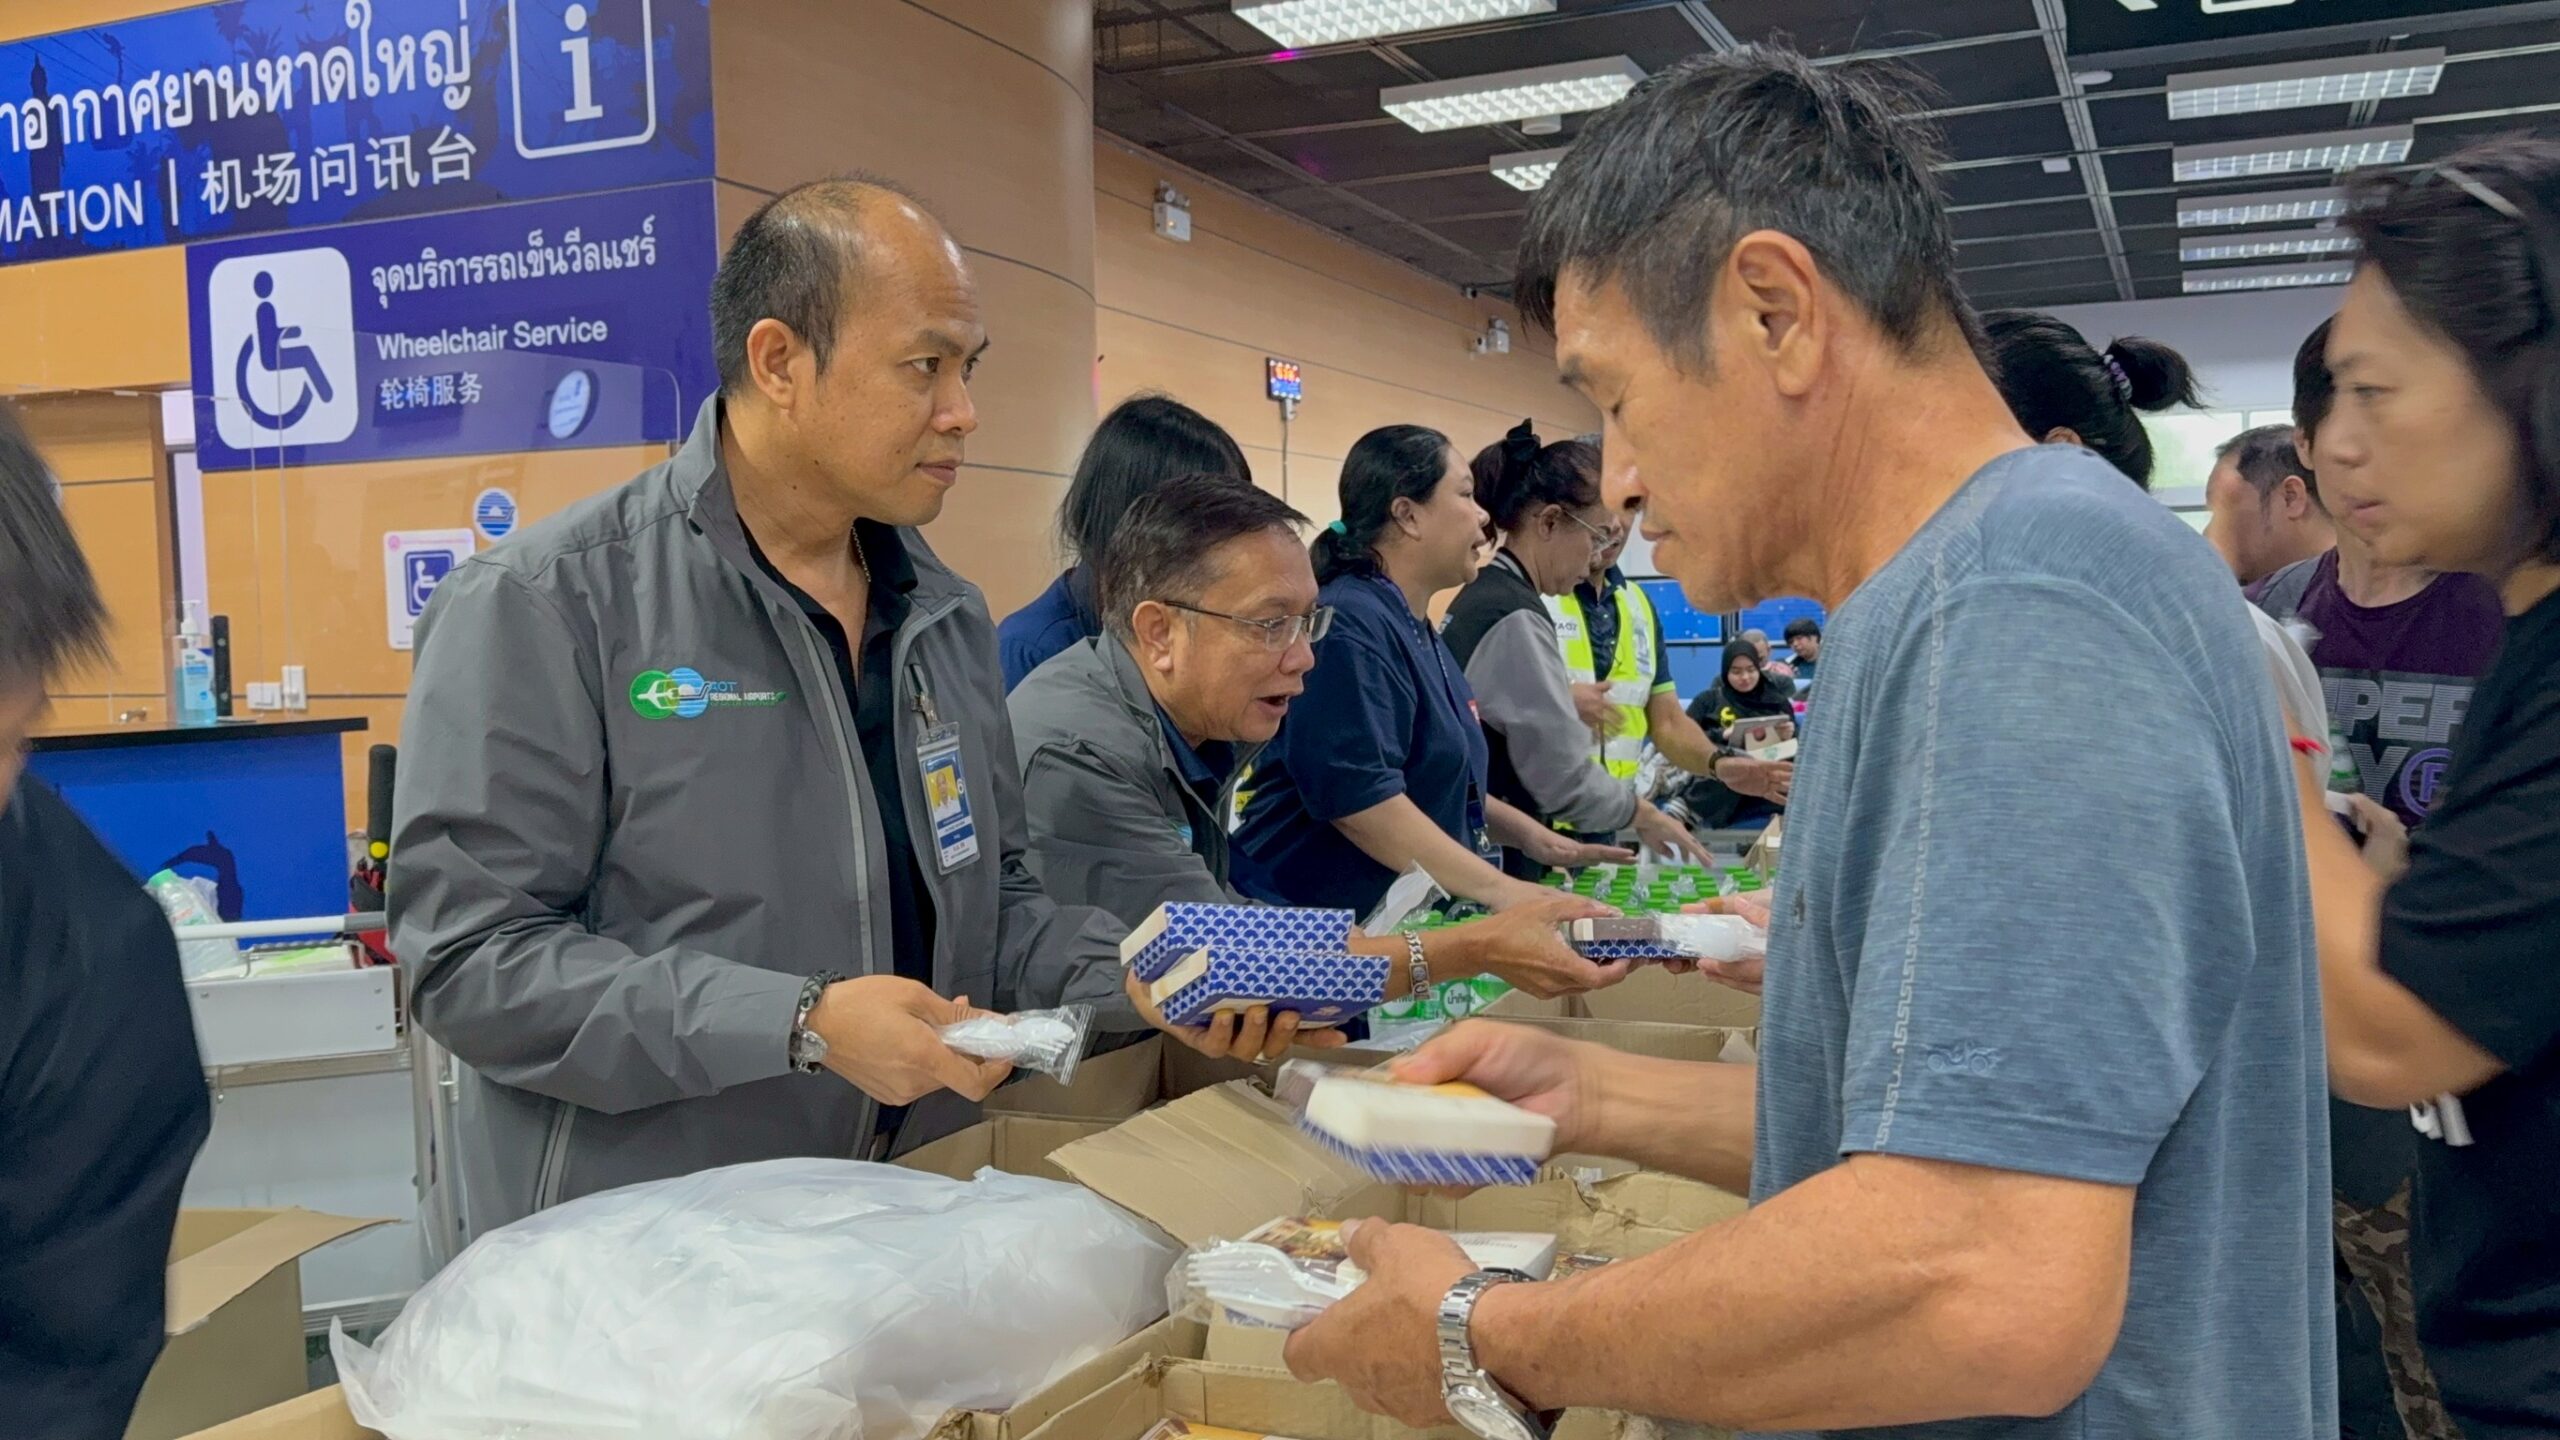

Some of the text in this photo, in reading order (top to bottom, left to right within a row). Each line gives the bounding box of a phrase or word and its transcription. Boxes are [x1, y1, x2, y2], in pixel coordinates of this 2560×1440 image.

[201, 125, 477, 216] 机场问讯台
[370, 214, 657, 309] จุดบริการรถเข็นวีลแชร์
[376, 316, 608, 361] Wheelchair Service
[380, 371, 483, 411] 轮椅服务
